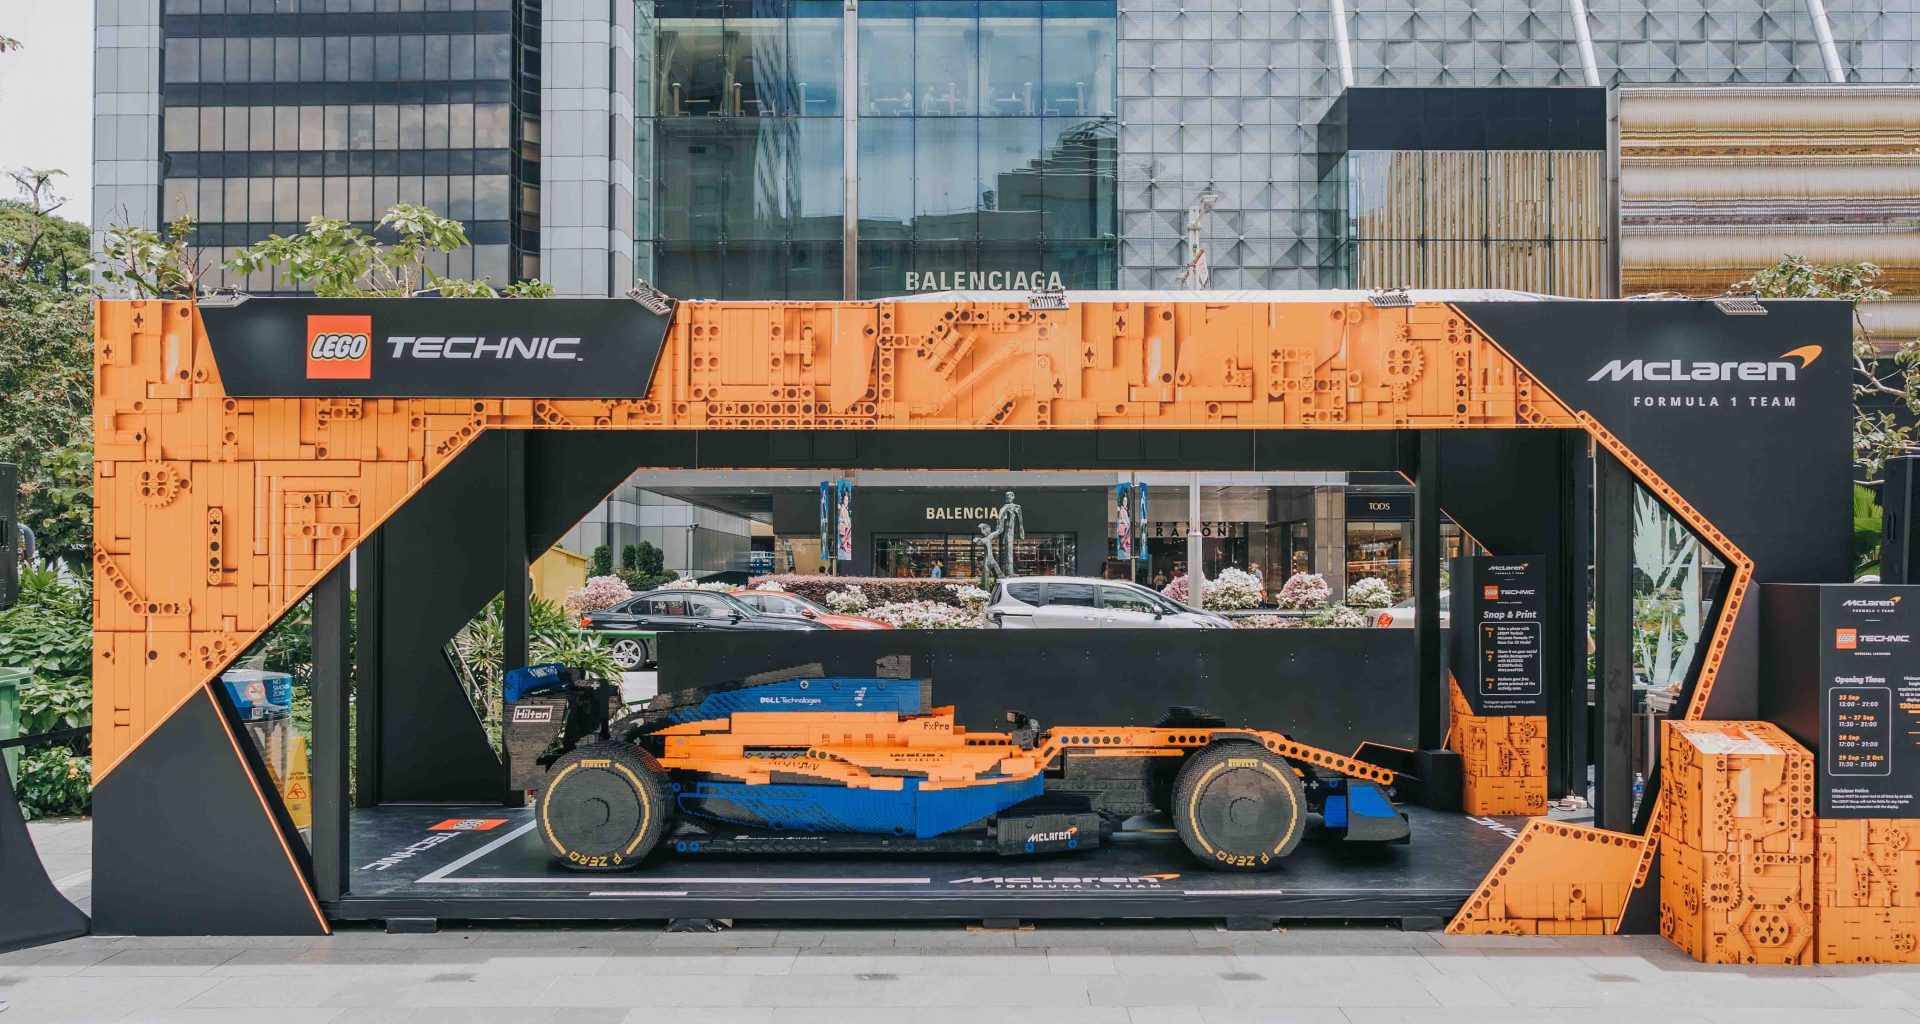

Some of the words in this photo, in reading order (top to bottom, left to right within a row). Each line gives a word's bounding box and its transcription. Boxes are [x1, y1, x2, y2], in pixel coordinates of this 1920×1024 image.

[905, 271, 1063, 291] BALENCIAGA
[311, 333, 369, 361] LEGO
[387, 337, 581, 359] TECHNIC
[1587, 356, 1800, 382] McLaren
[1633, 396, 1719, 407] FORMULA
[1730, 396, 1737, 407] 1
[1749, 396, 1796, 407] TEAM
[926, 507, 1008, 520] BALENCIA
[1842, 598, 1896, 607] McLaren
[1483, 611, 1505, 620] Snap
[1507, 611, 1514, 619] &
[1516, 610, 1537, 619] Print
[1835, 676, 1864, 684] Opening
[781, 696, 821, 705] Technologies
[516, 709, 549, 719] Hilton
[924, 722, 950, 730] FxPro
